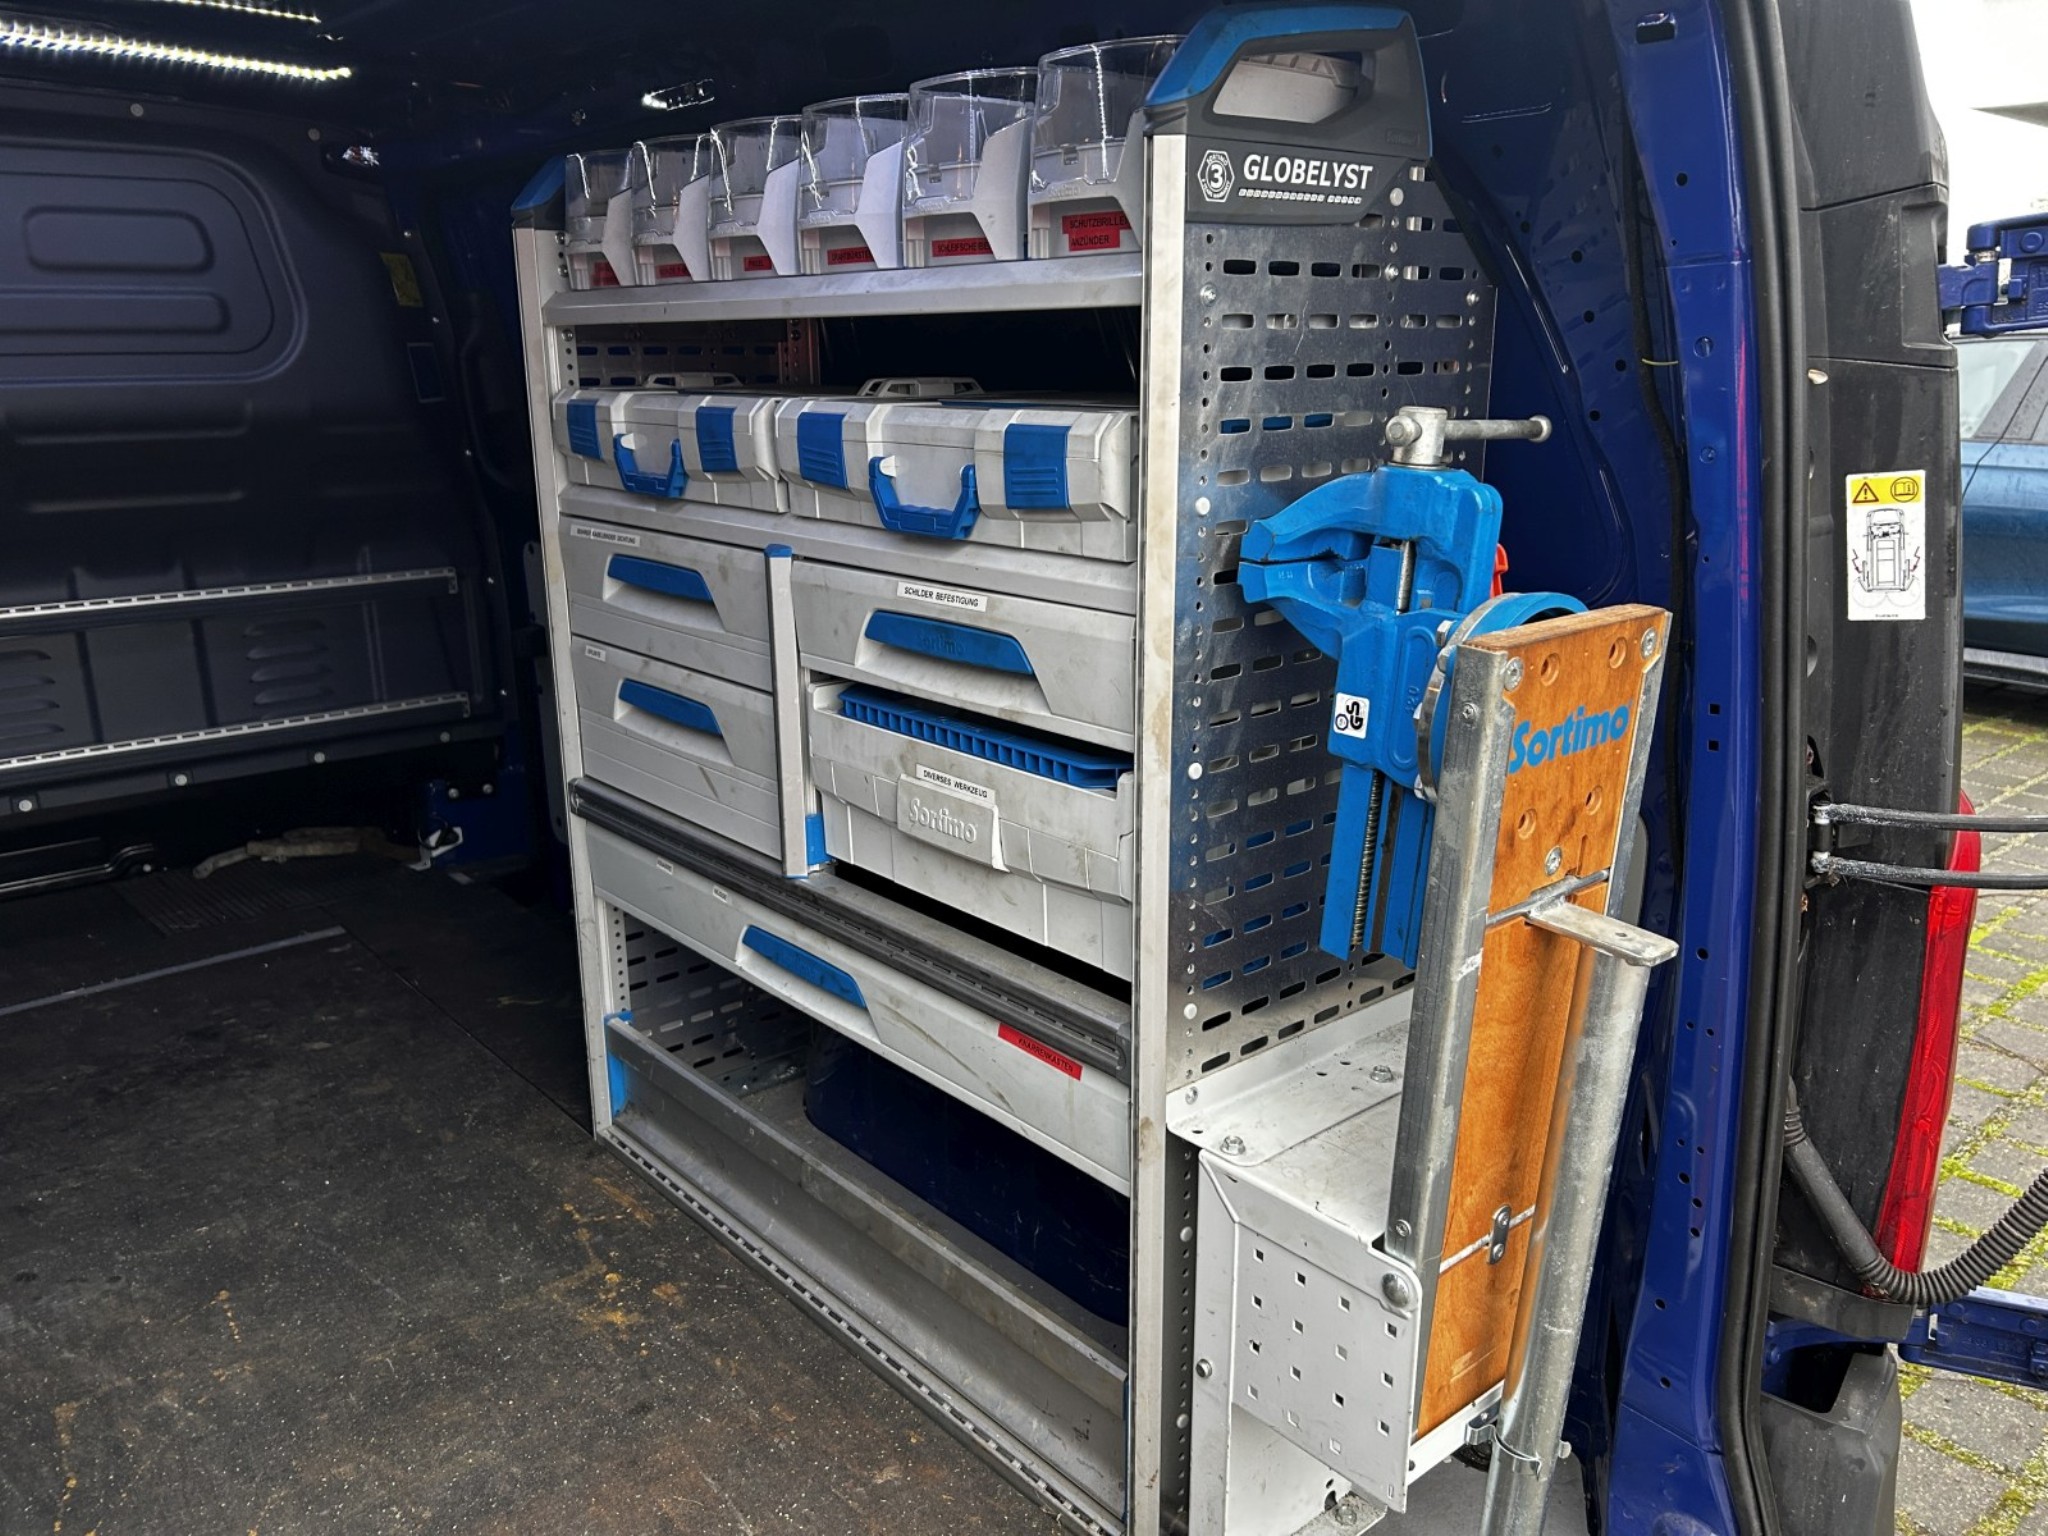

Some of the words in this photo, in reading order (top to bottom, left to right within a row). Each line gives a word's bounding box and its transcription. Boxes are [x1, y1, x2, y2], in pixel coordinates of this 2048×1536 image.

[1210, 163, 1223, 189] 3
[1243, 154, 1373, 190] GLOBELYST
[904, 586, 933, 599] SCHILDER
[935, 591, 979, 608] BEFESTIGUNG
[1346, 701, 1364, 730] GS
[1507, 704, 1630, 774] Sortimo
[923, 769, 952, 786] DIVERSES
[954, 781, 988, 799] WERKZEUG
[909, 798, 977, 844] Sortimo
